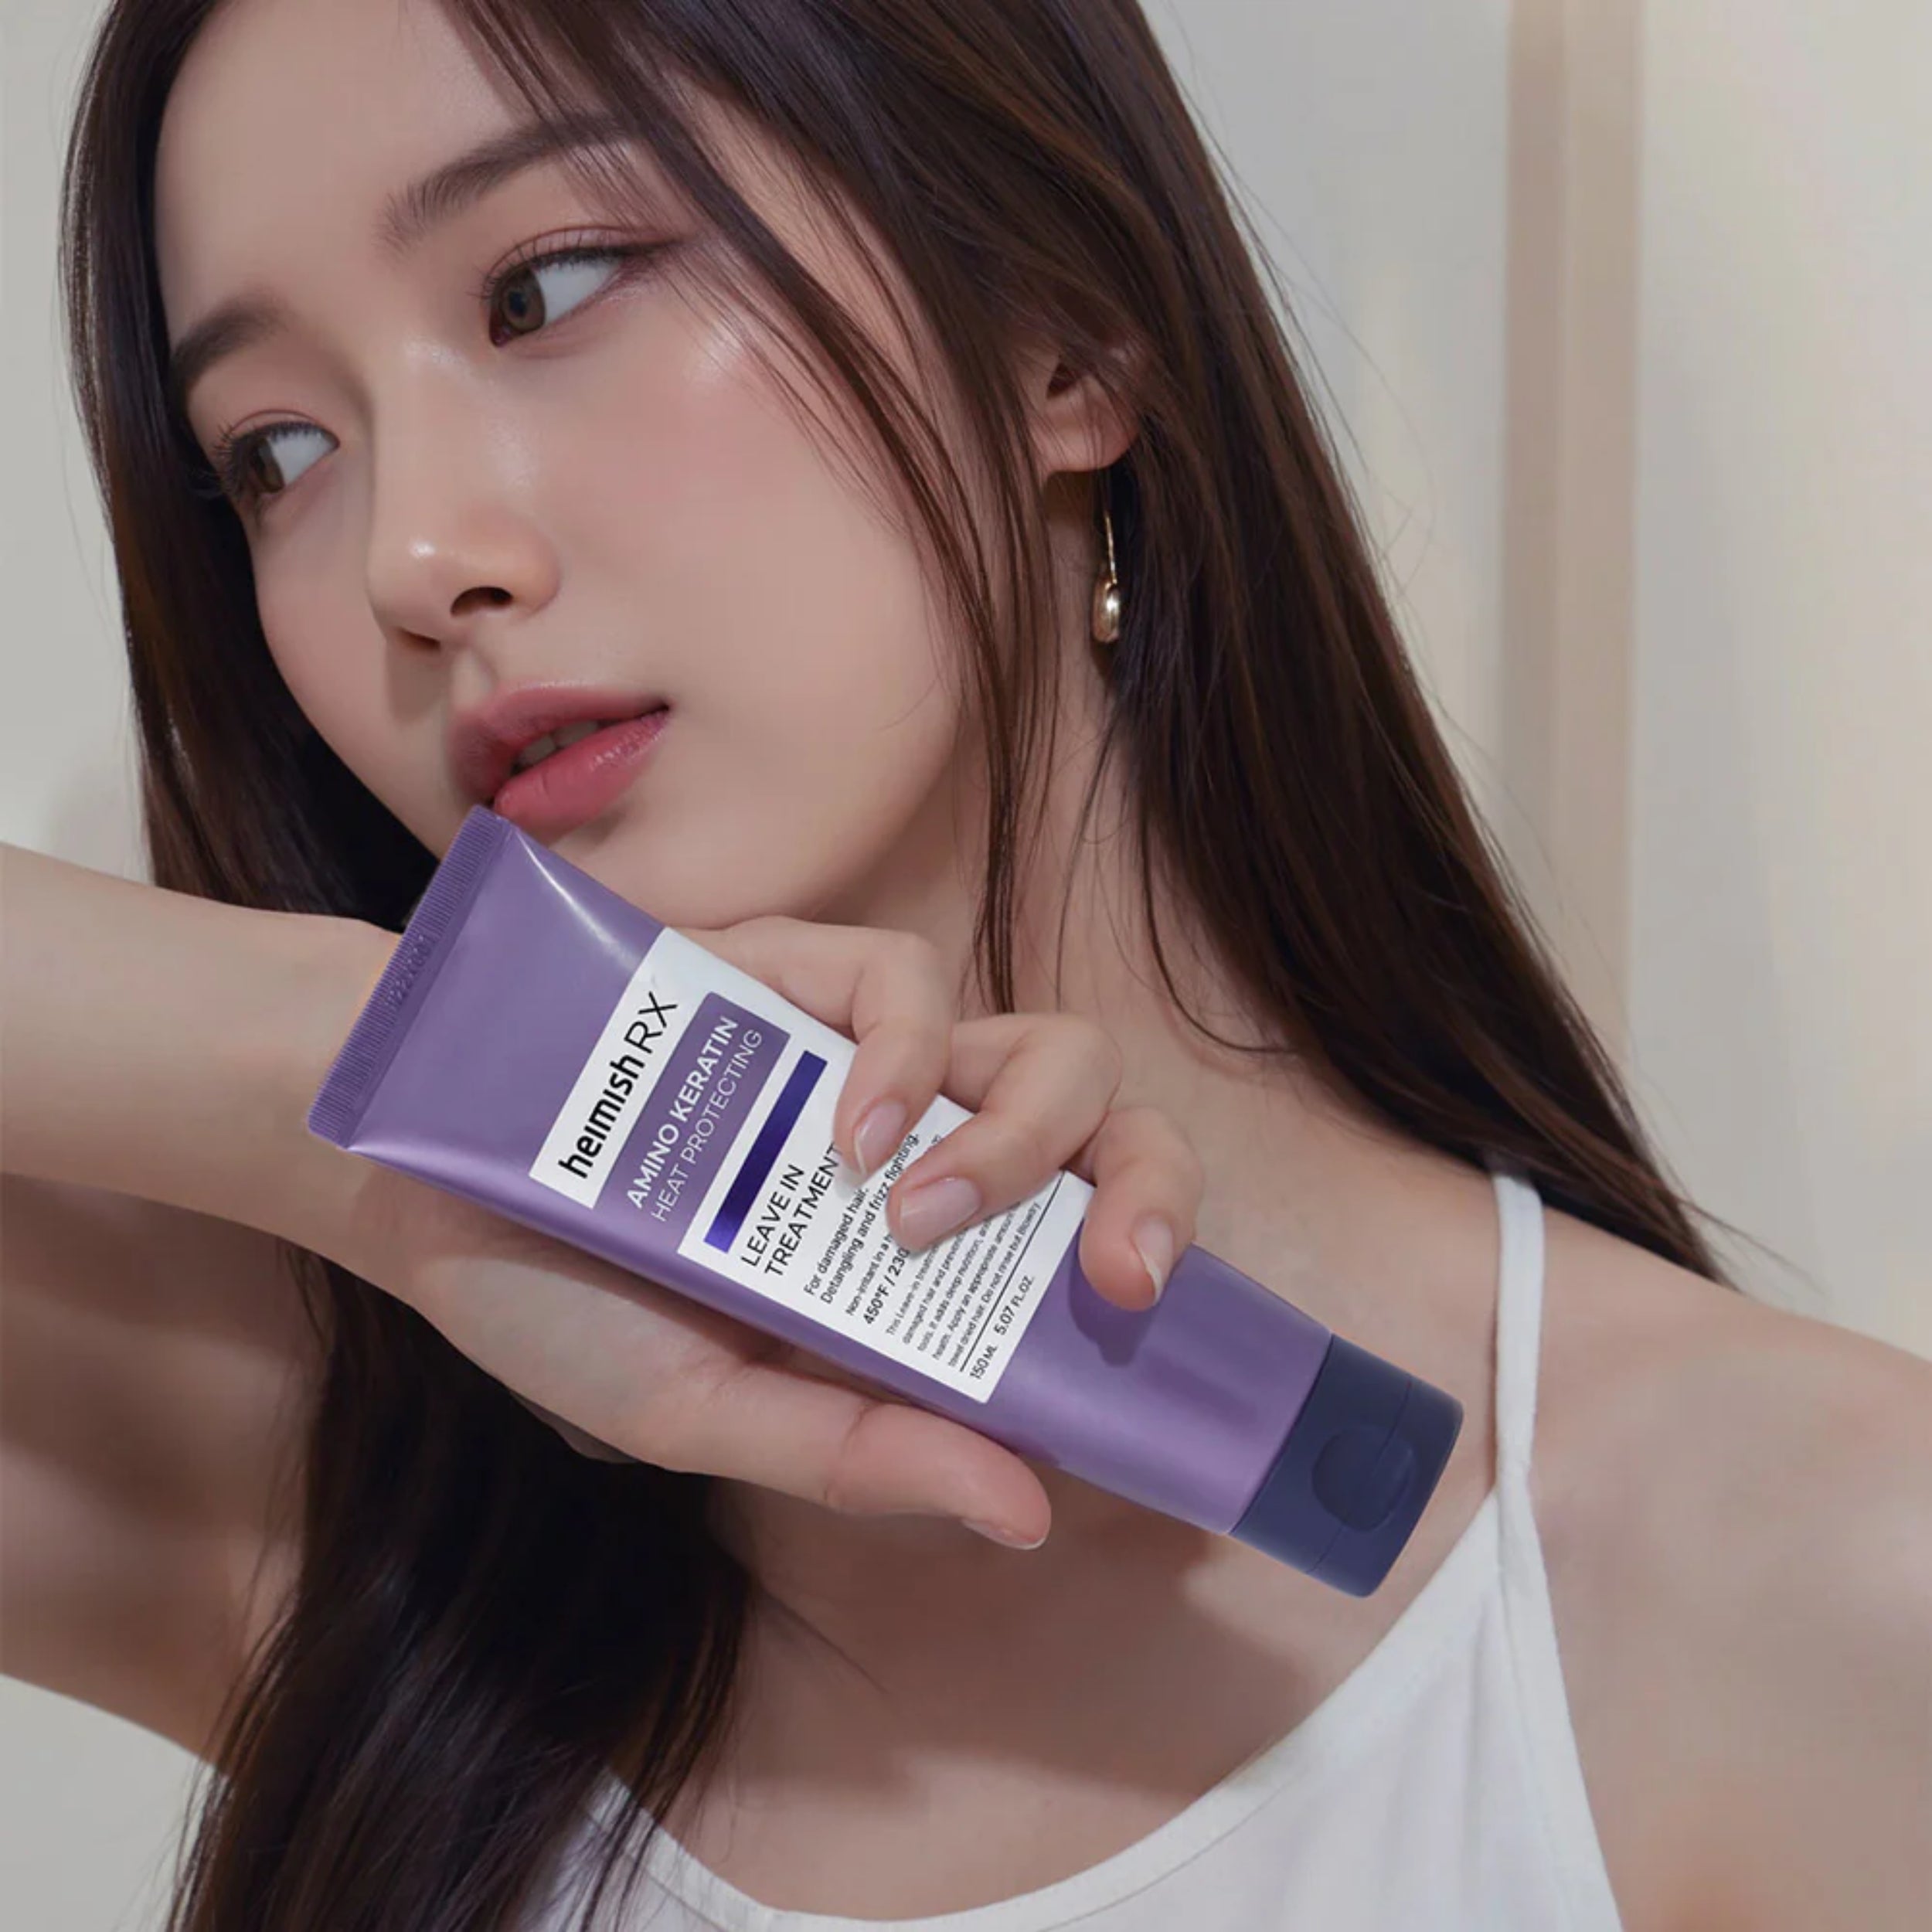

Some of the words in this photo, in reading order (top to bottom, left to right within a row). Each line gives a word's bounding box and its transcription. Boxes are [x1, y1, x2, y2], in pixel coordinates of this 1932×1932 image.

[558, 1054, 645, 1179] heimish
[624, 991, 678, 1054] RX
[627, 1124, 679, 1209] AMINO
[669, 1017, 738, 1122] KERATIN
[650, 1163, 689, 1223] HEAT
[679, 1029, 762, 1165] PROTECTING
[740, 1191, 791, 1267] LEAVE
[780, 1164, 804, 1191] IN
[764, 1142, 843, 1276] TREATMENT
[803, 1274, 822, 1296] For
[817, 1213, 854, 1274] damaged
[846, 1185, 869, 1214] hair.
[820, 1237, 865, 1304] Detangling
[857, 1209, 876, 1237] and
[868, 1182, 890, 1211] frizz
[883, 1133, 920, 1182] fighting.
[872, 1250, 886, 1262] in
[880, 1243, 889, 1251] a
[933, 1268, 946, 1287] and
[945, 1274, 962, 1300] deep
[981, 1288, 994, 1304] Do
[989, 1272, 1003, 1290] not
[1009, 1234, 1022, 1251] but
[863, 1284, 889, 1325] 450°F
[883, 1274, 896, 1287] /
[961, 1294, 972, 1307] an
[993, 1305, 1015, 1335] 5.07
